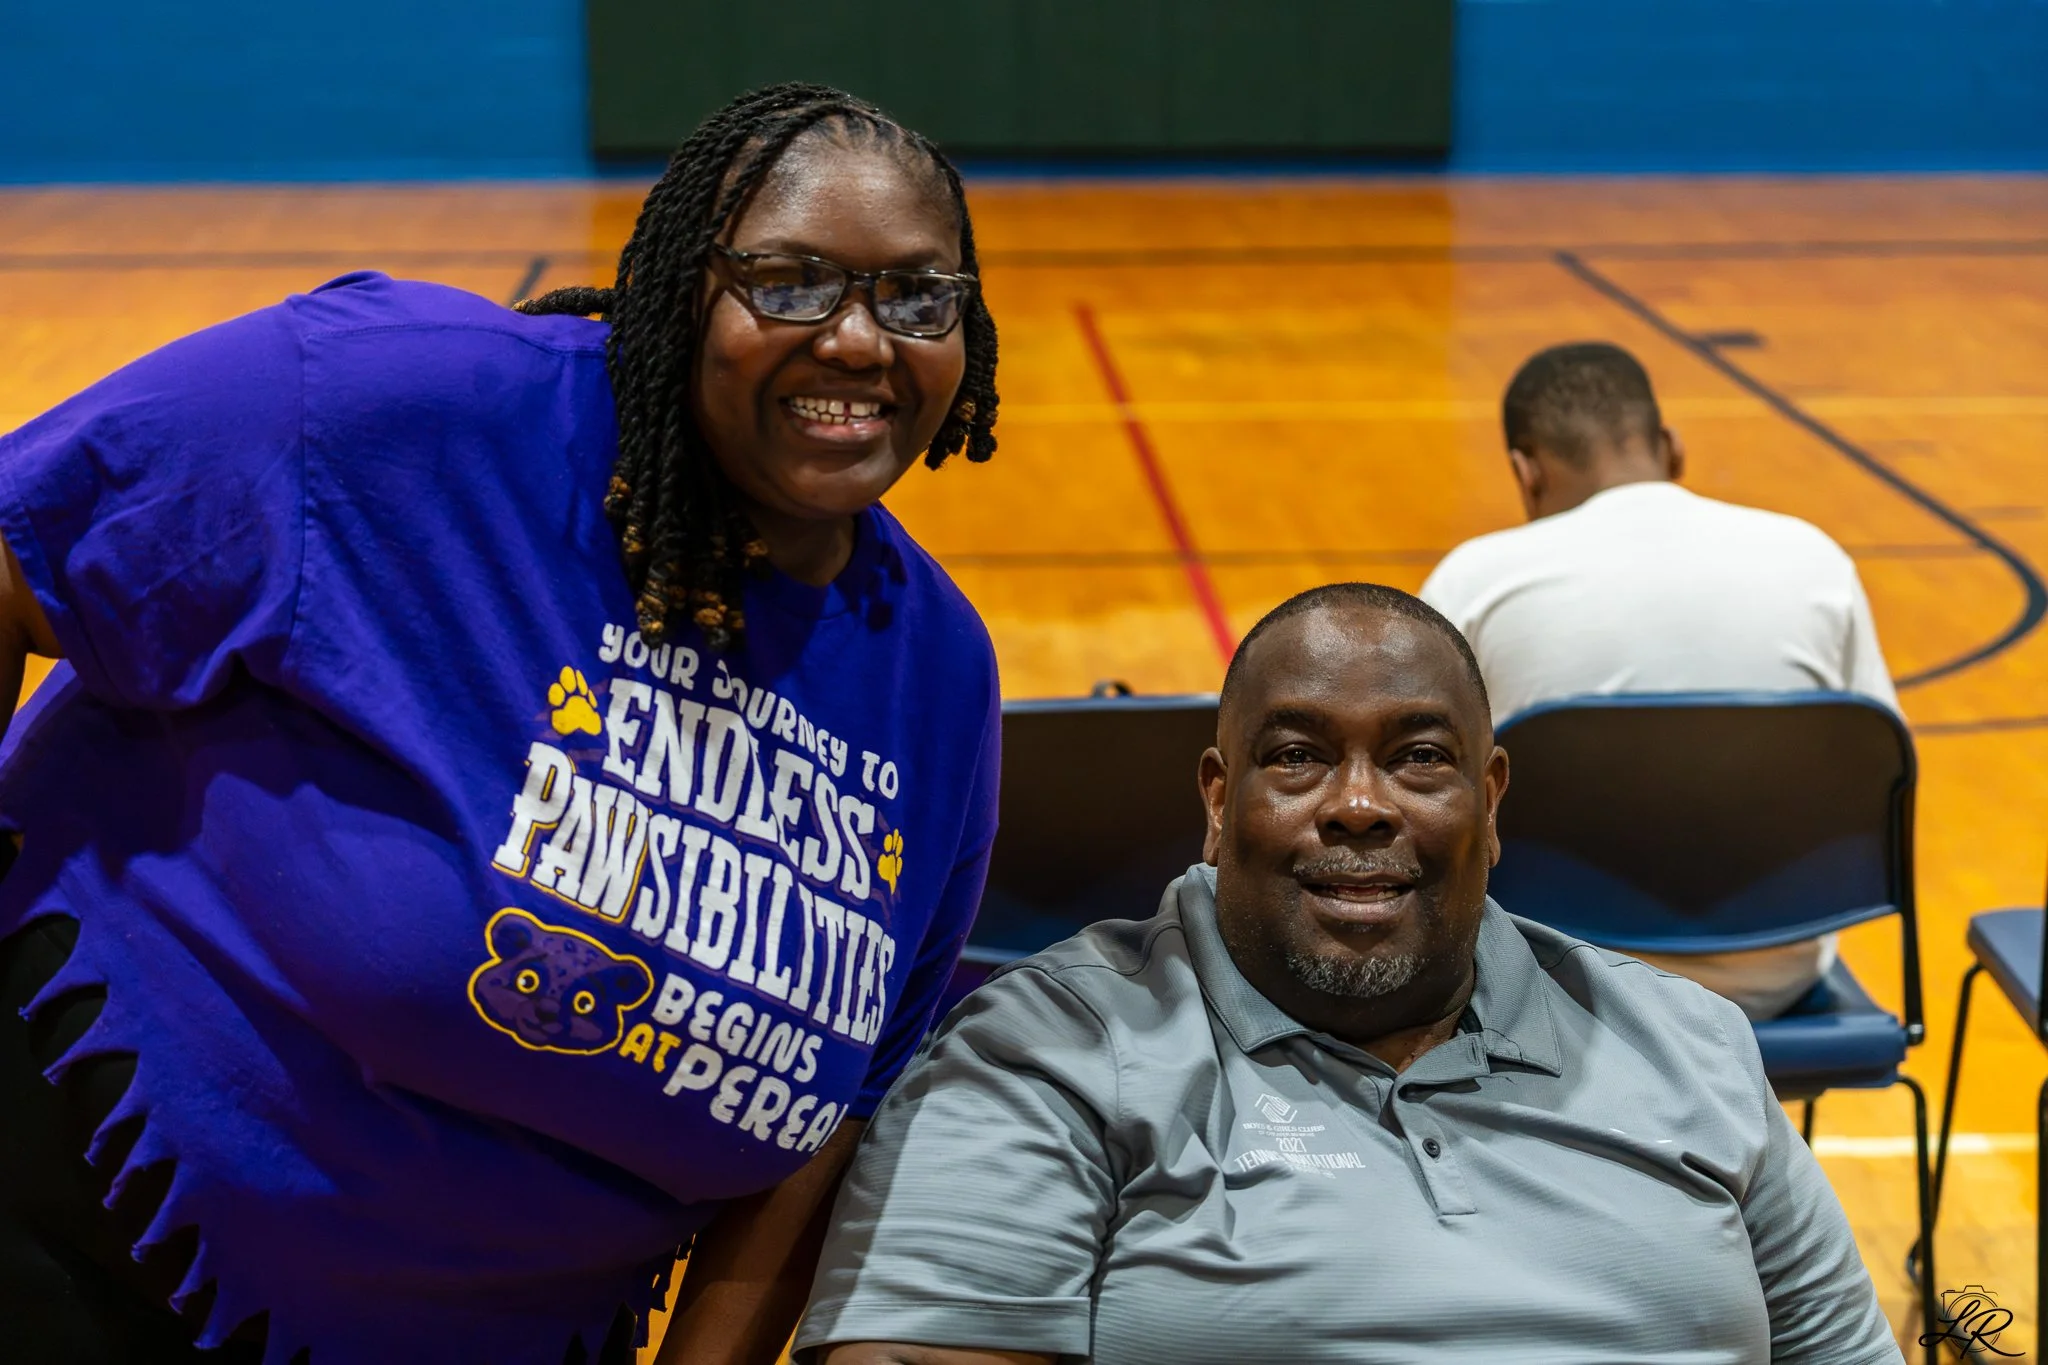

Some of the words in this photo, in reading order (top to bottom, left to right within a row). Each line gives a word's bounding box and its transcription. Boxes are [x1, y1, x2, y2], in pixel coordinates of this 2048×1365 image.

[598, 623, 699, 690] YOUR
[712, 659, 848, 777] JOURNEY
[861, 750, 899, 800] TO
[602, 678, 874, 900] ENDLESS
[493, 741, 896, 1046] PAWSIBILITIES
[618, 1023, 682, 1073] AT
[662, 1043, 849, 1157] PEREA
[651, 973, 823, 1083] BEGINS
[1275, 1137, 1307, 1153] 2021
[1297, 1125, 1326, 1133] CLUBS
